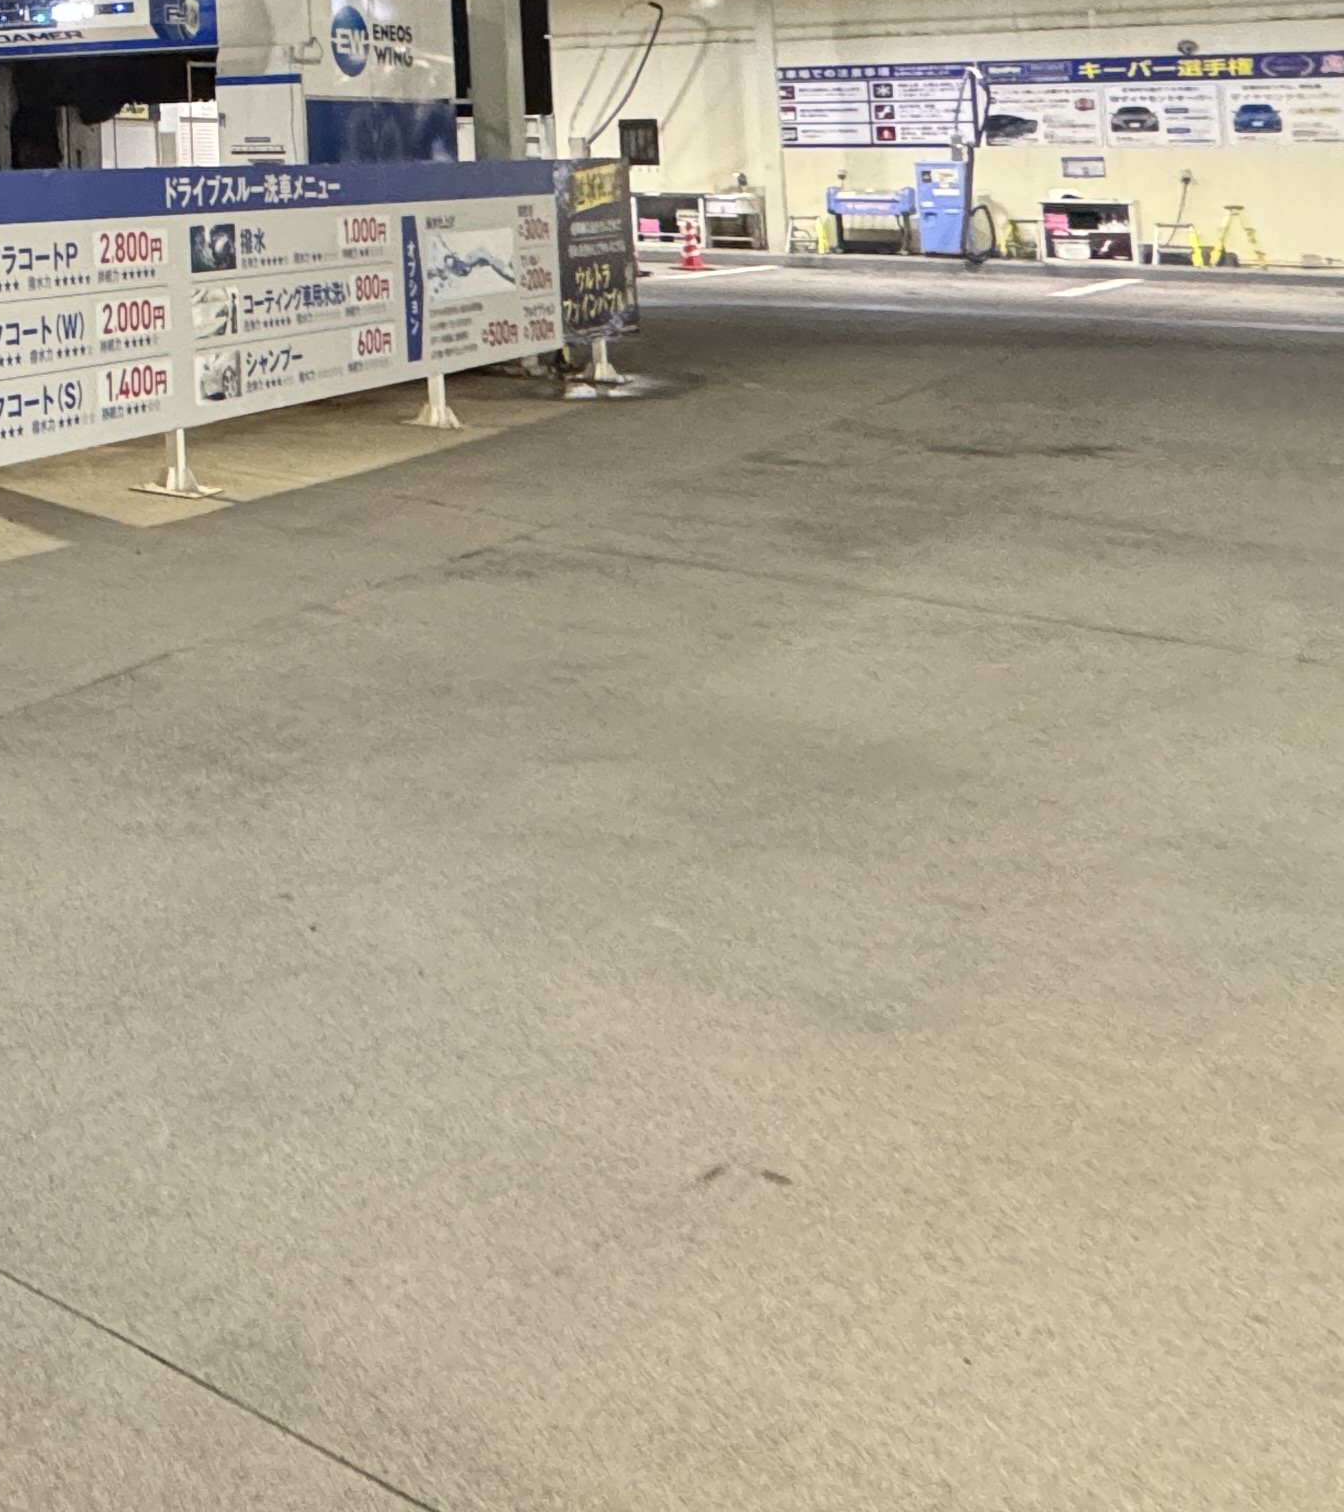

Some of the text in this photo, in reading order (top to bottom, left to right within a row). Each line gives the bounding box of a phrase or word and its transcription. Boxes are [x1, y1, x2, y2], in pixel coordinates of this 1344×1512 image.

[372, 23, 413, 44] ENEOS
[373, 45, 413, 68] WING
[1078, 57, 1255, 80] キーパー選手権
[165, 173, 341, 209] ドライブスルー洗車メニュー
[355, 274, 390, 302] 800円
[357, 328, 392, 357] 600円
[246, 345, 303, 378] シャンプー
